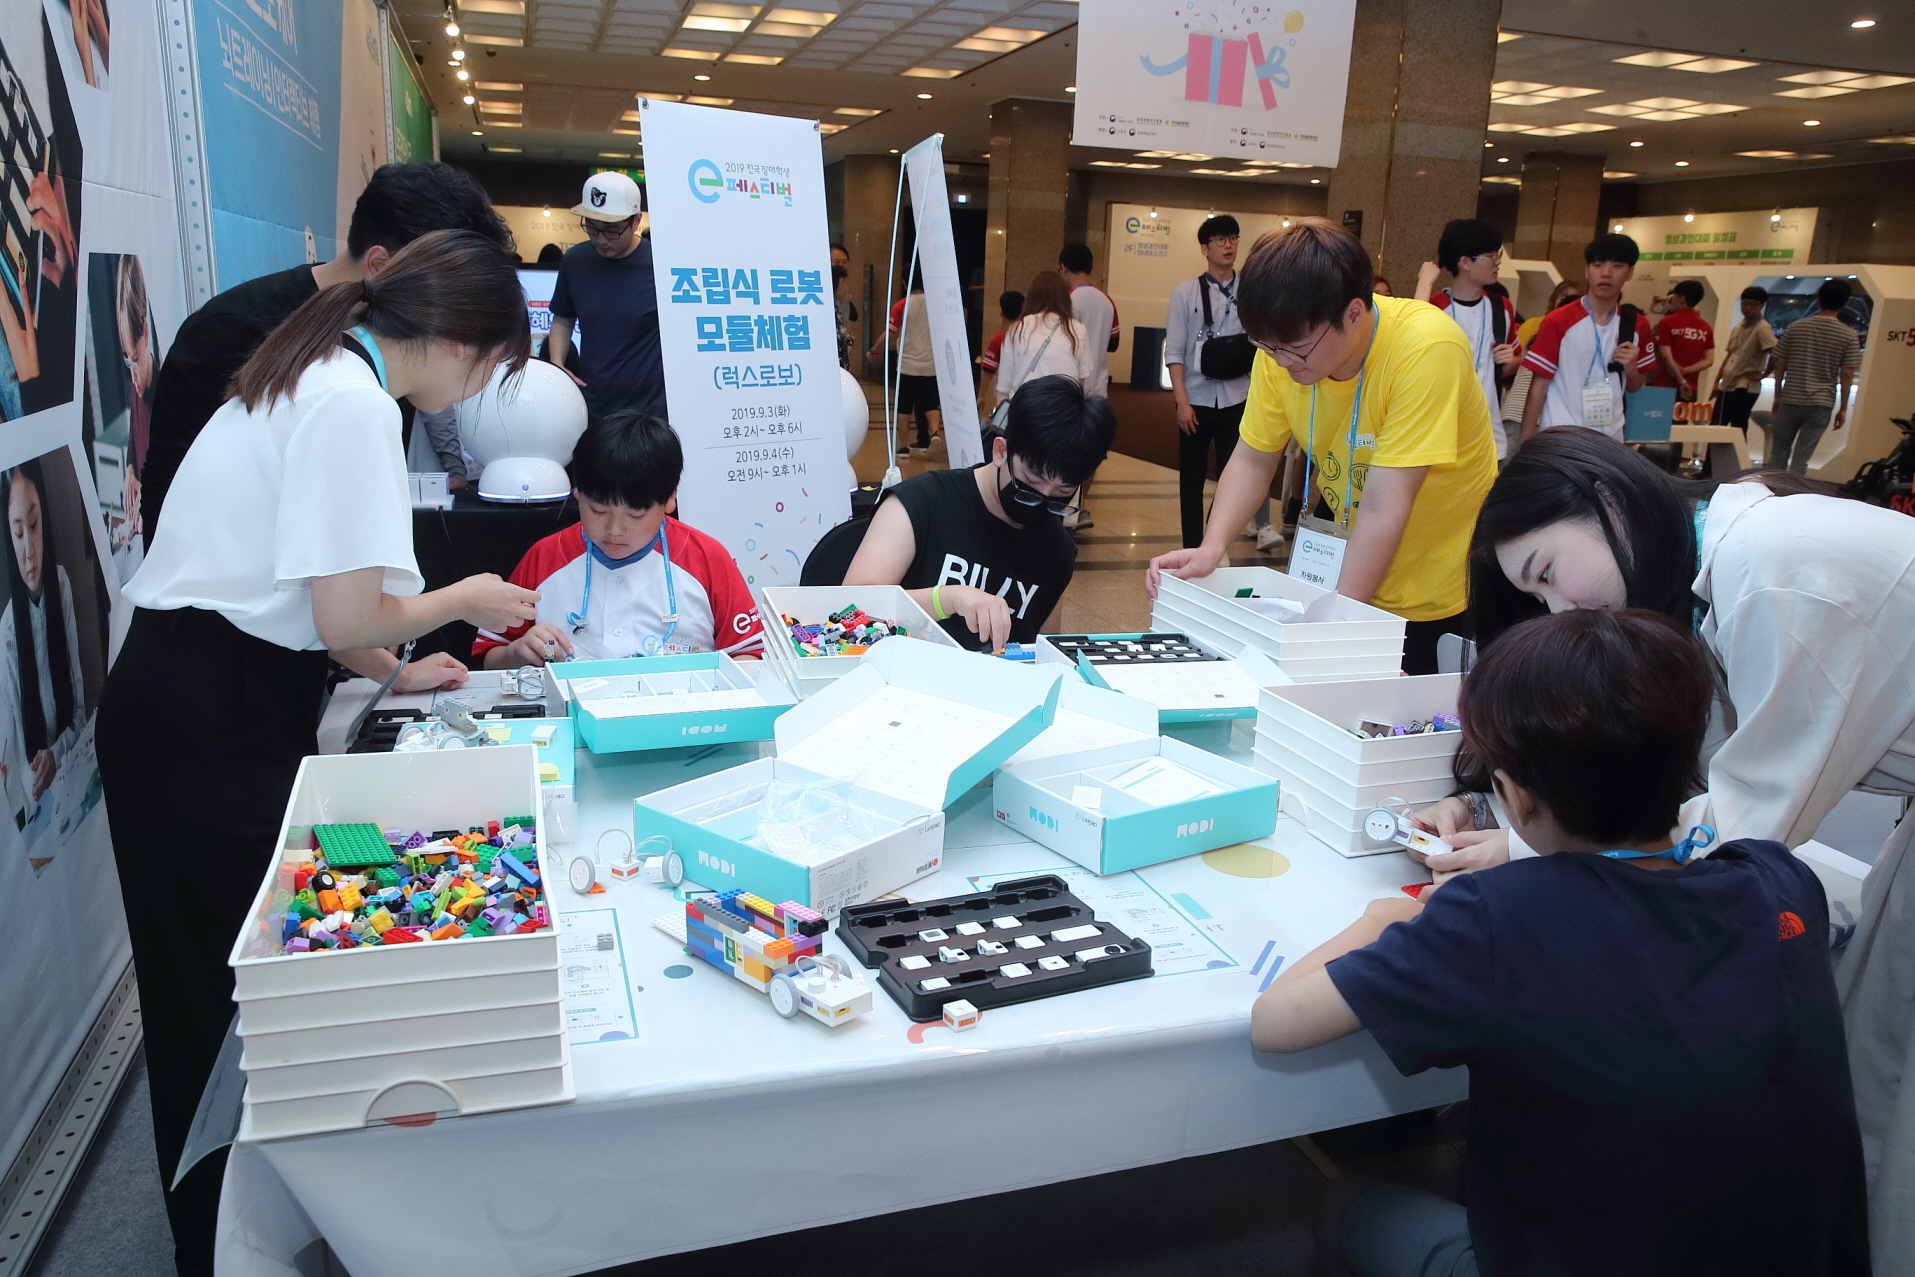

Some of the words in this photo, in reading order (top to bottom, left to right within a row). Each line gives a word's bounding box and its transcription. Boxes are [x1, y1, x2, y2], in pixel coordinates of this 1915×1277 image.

[725, 162, 745, 173] 2019
[746, 164, 761, 175] 전국
[761, 165, 790, 178] 장애학생
[726, 177, 793, 207] 페스티벌
[670, 267, 759, 305] 조립식
[770, 269, 824, 306] 로봇
[696, 315, 811, 353] 모듈체험
[1887, 330, 1907, 342] SKT
[713, 362, 803, 391] (럭스로보)
[731, 403, 791, 420] 2019.9.3(화)
[722, 424, 742, 440] 오후
[743, 423, 766, 439] 2시~
[767, 421, 786, 436] 오후
[787, 421, 803, 435] 6시
[735, 446, 795, 463] 2019.9.4(수)
[726, 467, 746, 482] 오전
[747, 466, 769, 480] 9시~
[771, 463, 790, 478] 오후
[792, 463, 807, 476] 1시
[1300, 570, 1325, 584] 자원봉사
[1029, 806, 1059, 833] MODI
[1176, 817, 1215, 839] MODI
[698, 849, 737, 878] MODI
